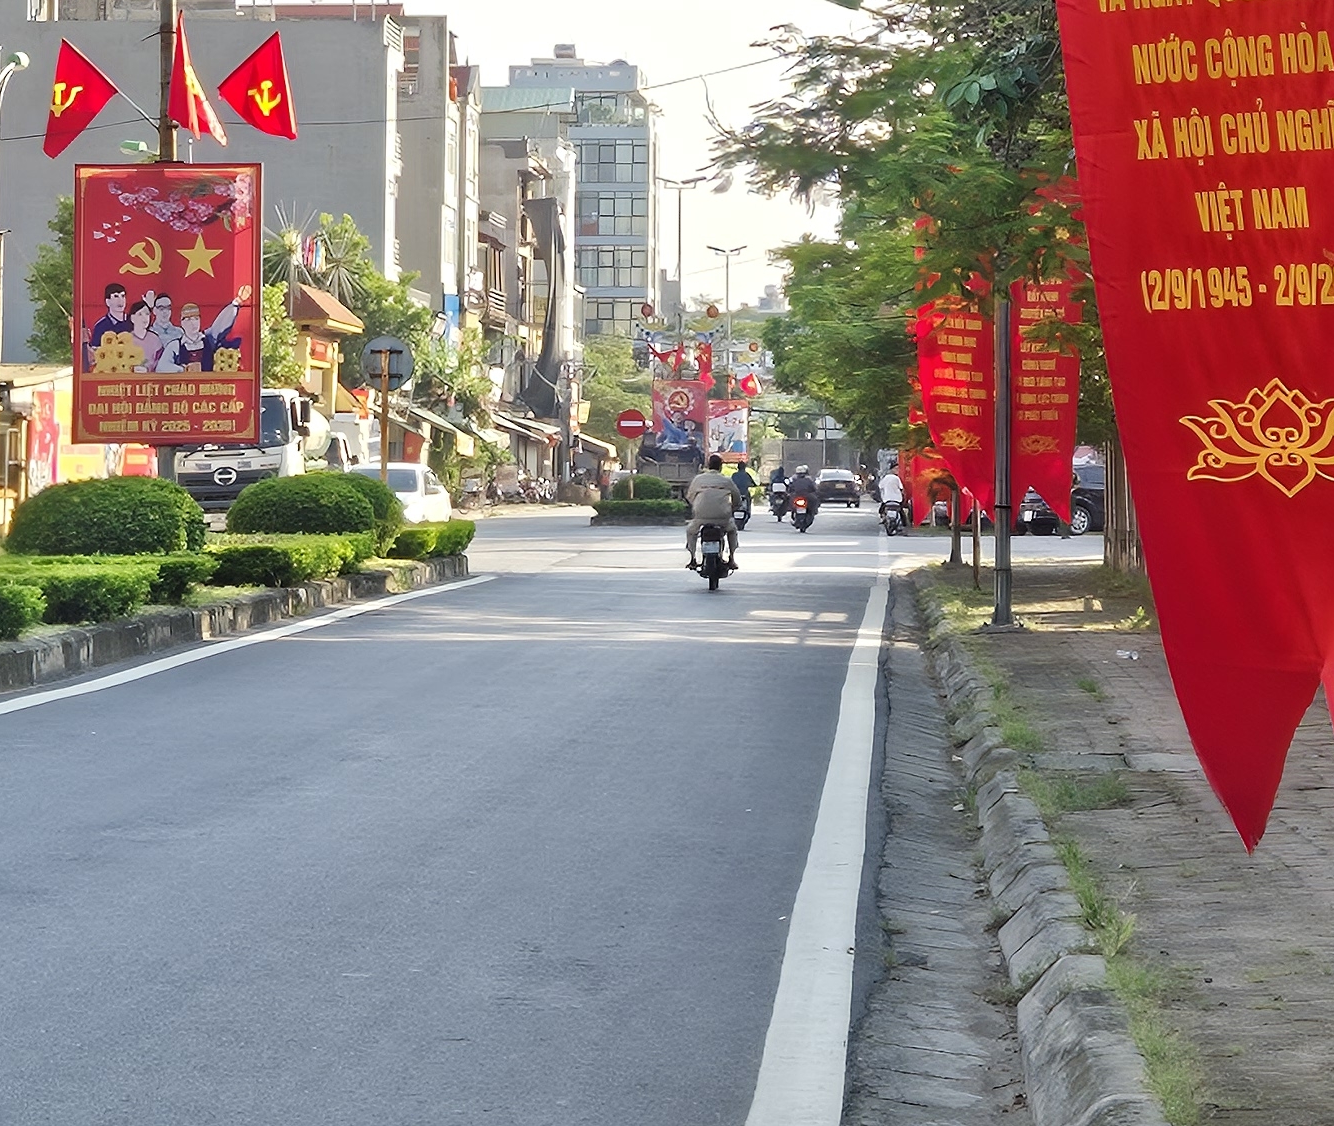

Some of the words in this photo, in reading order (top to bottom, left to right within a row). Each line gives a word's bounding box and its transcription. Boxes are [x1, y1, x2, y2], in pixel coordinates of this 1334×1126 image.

[1132, 33, 1198, 85] NƯỚC
[1204, 28, 1274, 88] CỘNG
[1279, 21, 1334, 74] HÒA
[1133, 110, 1168, 160] XÃ
[1172, 108, 1214, 166] HỘI
[1220, 97, 1268, 155] CHỦ
[1195, 181, 1244, 241] VIỆT
[1251, 186, 1310, 230] NAM
[1140, 266, 1253, 313] (2/9/1945
[1259, 283, 1267, 293] -
